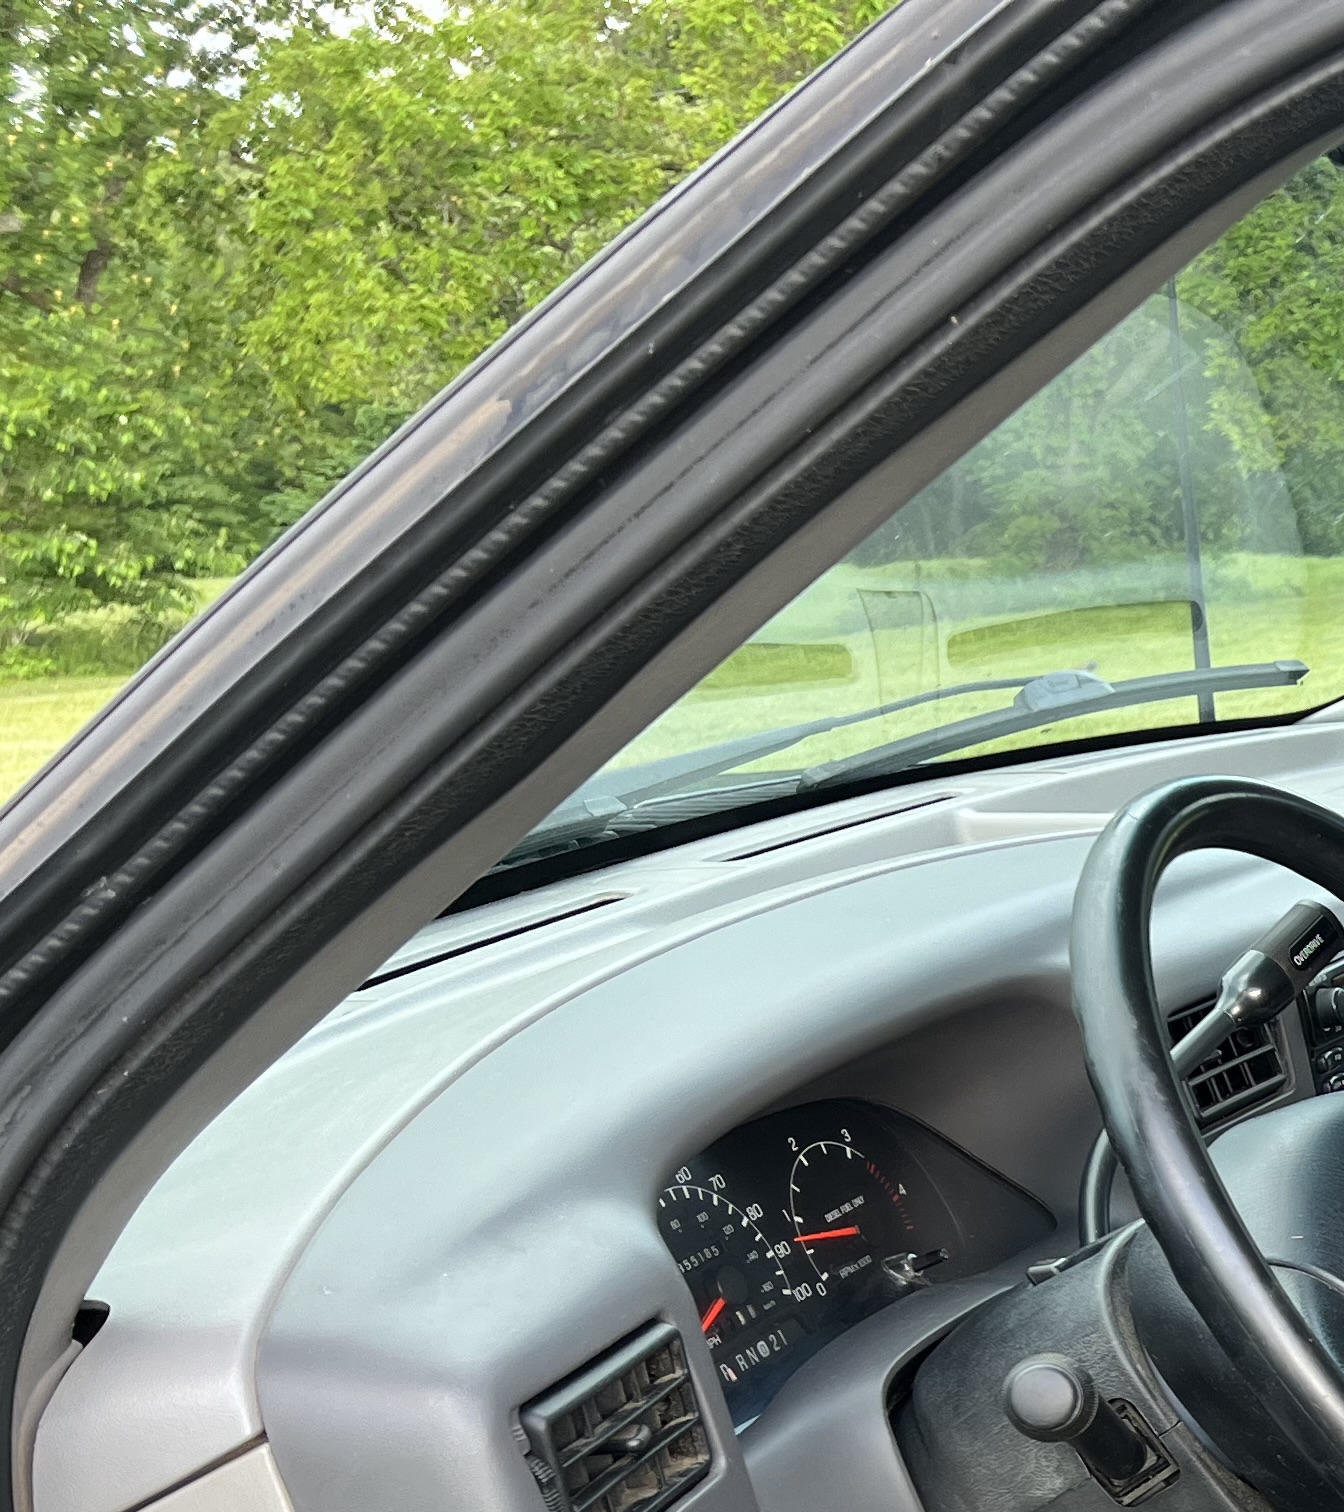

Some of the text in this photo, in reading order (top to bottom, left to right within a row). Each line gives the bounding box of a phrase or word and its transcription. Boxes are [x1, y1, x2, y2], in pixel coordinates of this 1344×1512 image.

[1293, 933, 1325, 966] OVERDRIVE
[787, 1136, 799, 1152] 2
[840, 1128, 852, 1143] 3
[675, 1166, 692, 1184] 60
[708, 1174, 726, 1192] 70
[745, 1203, 764, 1221] 80
[774, 1240, 792, 1259] 90
[792, 1282, 813, 1302] 100
